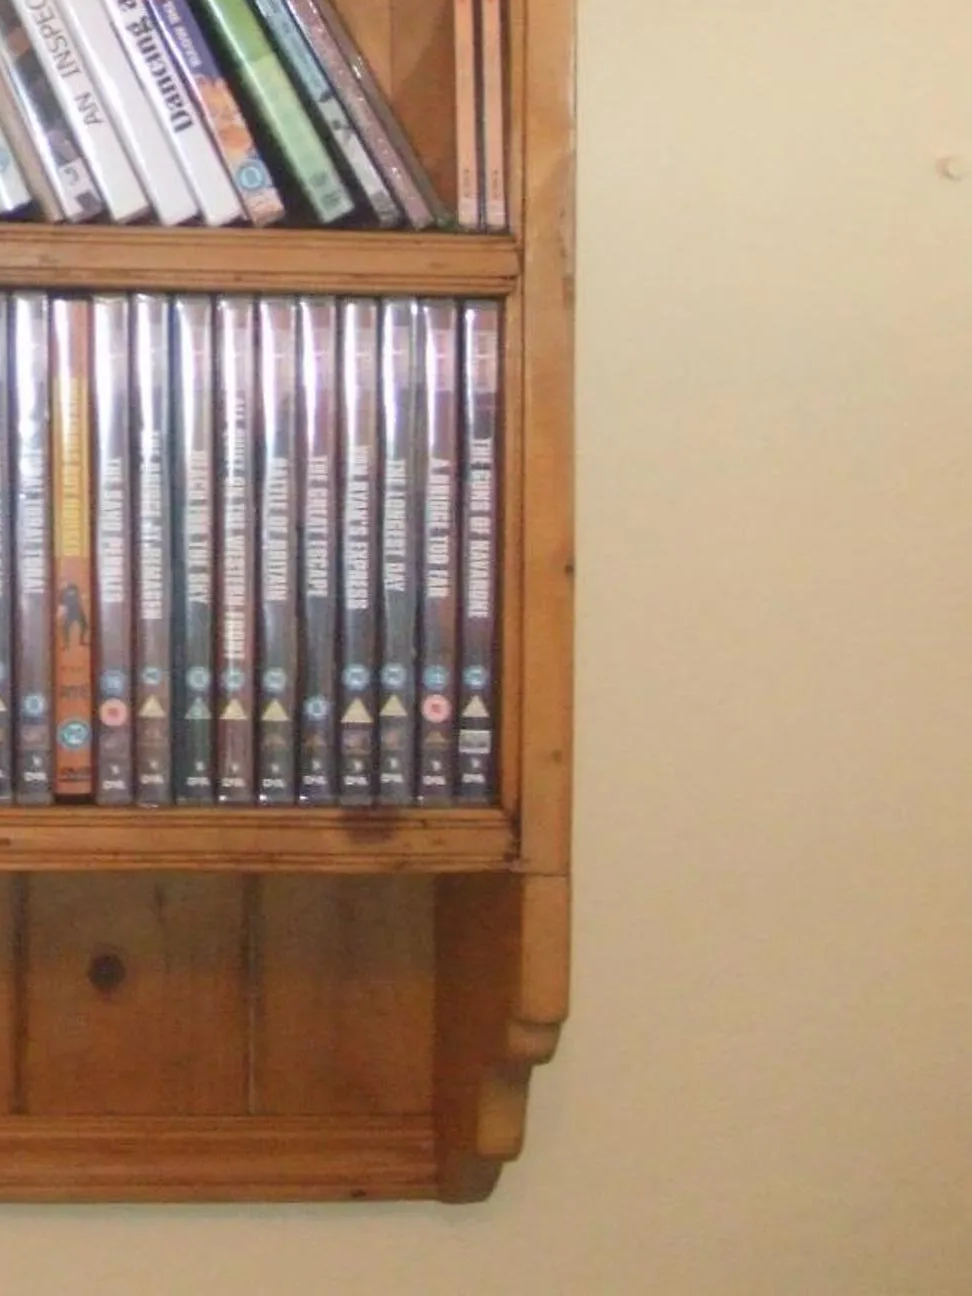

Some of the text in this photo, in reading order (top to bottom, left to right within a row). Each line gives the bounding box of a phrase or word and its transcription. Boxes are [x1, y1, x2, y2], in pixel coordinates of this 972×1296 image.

[126, 9, 195, 134] Dancing
[170, 22, 205, 69] MOVIE
[75, 91, 103, 127] AN
[102, 457, 124, 485] THE
[101, 489, 124, 532] SAND
[186, 449, 209, 605] REACH FOR THE SKY
[225, 503, 246, 530] THE
[265, 456, 288, 602] BATTLE OF BRITAIN
[307, 454, 329, 598] THE GREAT ESCAPE
[347, 481, 369, 535] RYAN'S
[384, 459, 406, 592] THE LONGEST DAY
[426, 458, 450, 598] A BRIDGE TOO FAR
[468, 437, 492, 618] THE GUNS OF NAVARONE
[141, 546, 163, 620] REMAGEN
[224, 535, 246, 606] WESTERN
[346, 541, 369, 609] EXPRESS
[224, 611, 246, 661] FRONT
